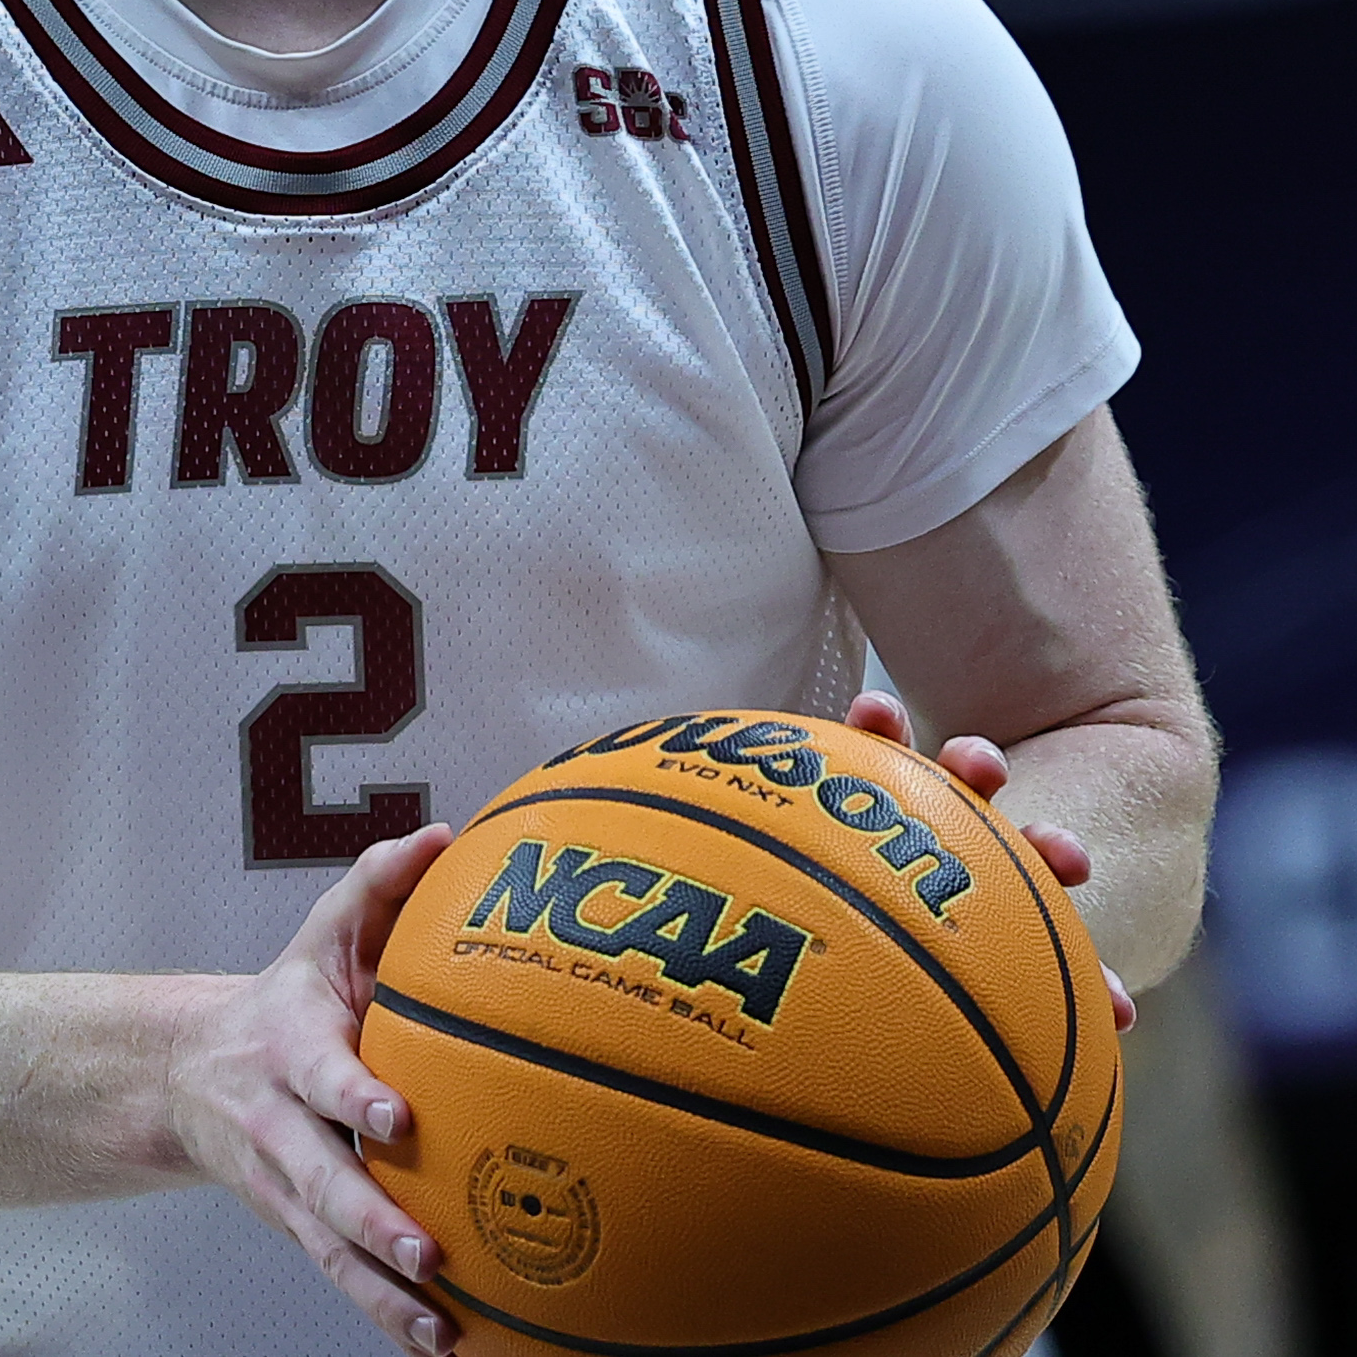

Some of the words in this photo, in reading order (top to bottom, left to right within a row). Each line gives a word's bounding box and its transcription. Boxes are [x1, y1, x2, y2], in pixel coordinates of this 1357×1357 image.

[51, 289, 584, 497] TROY
[235, 562, 431, 870] 2
[655, 758, 720, 781] EVO
[725, 774, 795, 808] NXT
[452, 939, 563, 973] OFFICIAL
[570, 961, 663, 1006] GAME
[669, 997, 756, 1051] BALL
[461, 838, 813, 1031] NCAA
